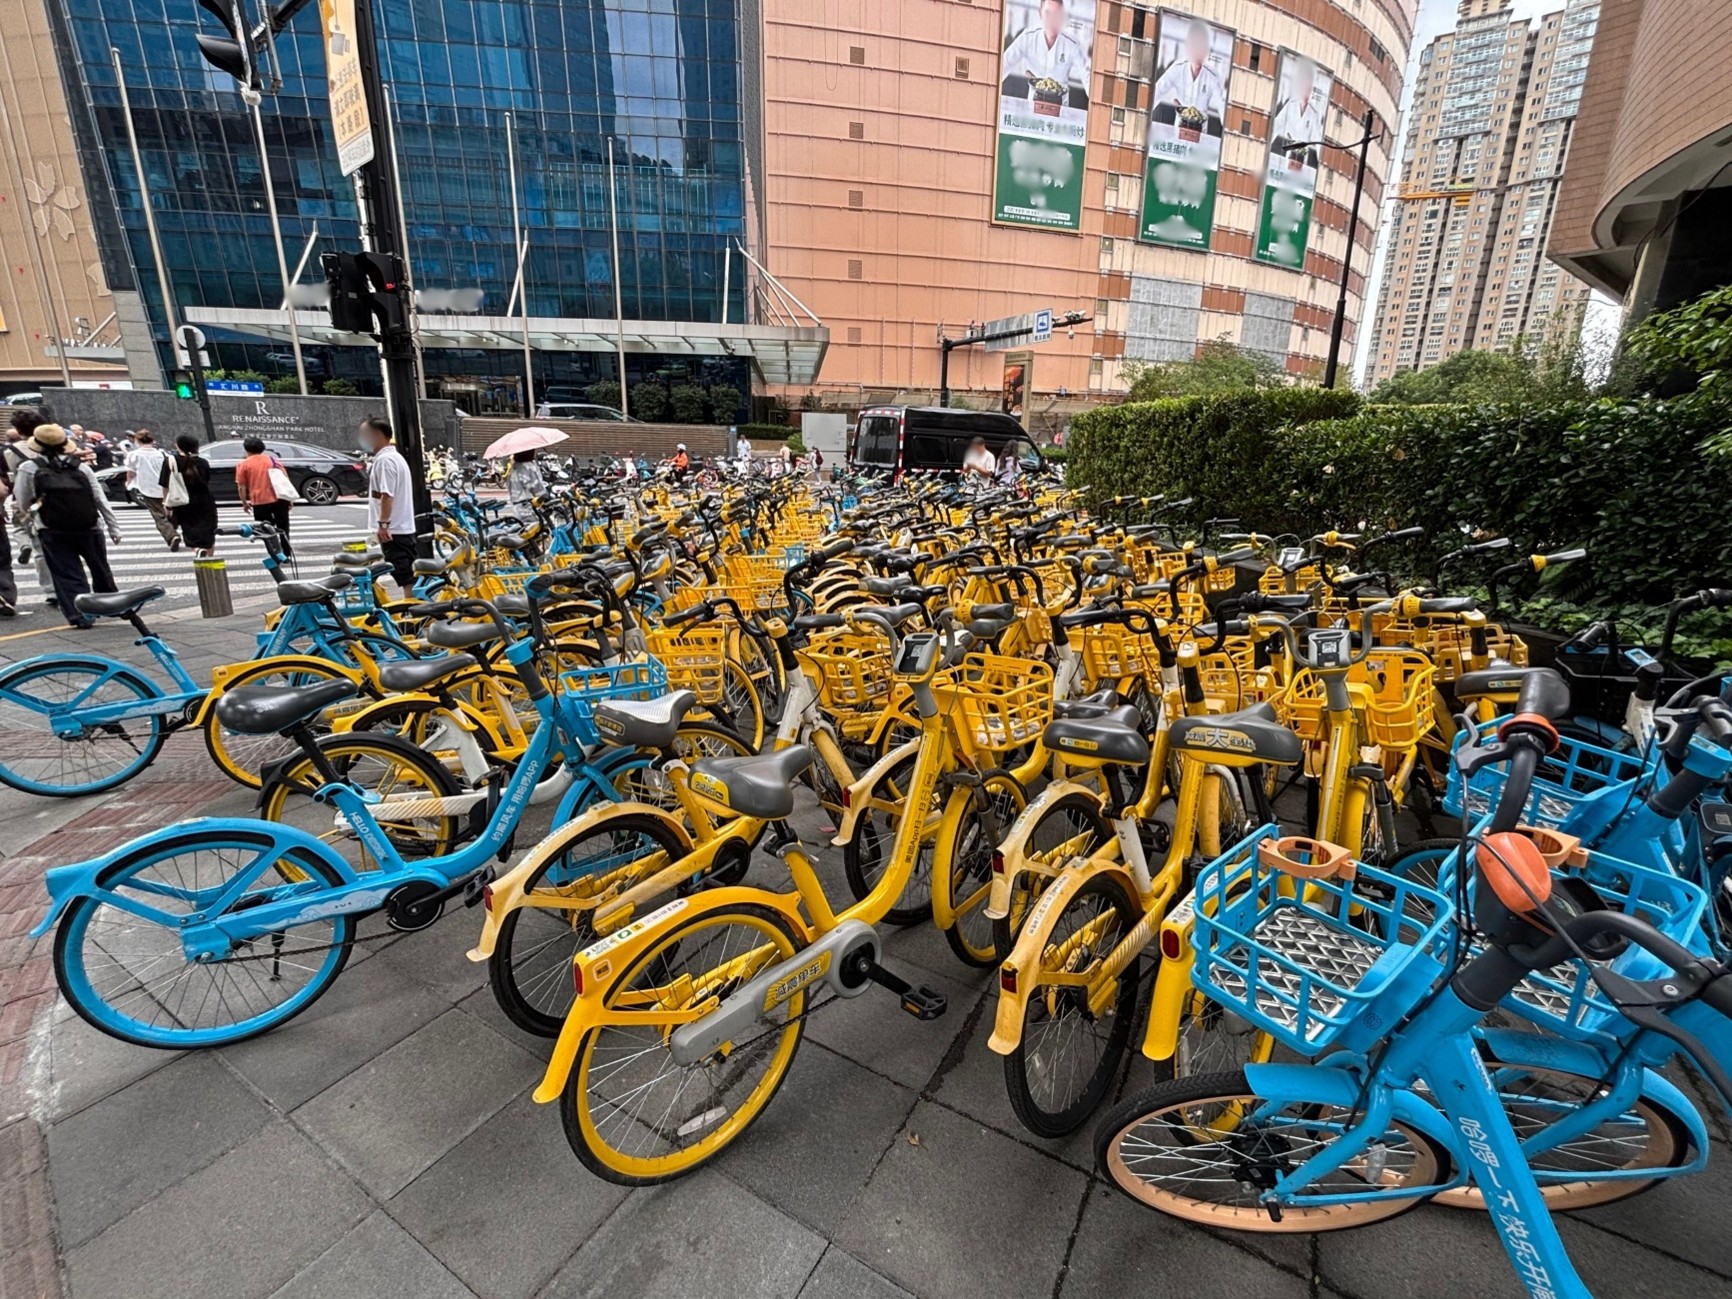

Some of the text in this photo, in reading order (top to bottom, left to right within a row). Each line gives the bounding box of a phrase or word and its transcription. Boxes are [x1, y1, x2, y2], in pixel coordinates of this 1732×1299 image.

[220, 383, 249, 391] 汇川路
[254, 401, 270, 415] R
[232, 415, 297, 425] RENAISSANCE
[491, 759, 539, 842] 约顺风车 用哈啰APP
[349, 811, 370, 834] HELLO
[905, 802, 927, 863] 美团App扫一扫
[776, 961, 822, 1001] 减震单车
